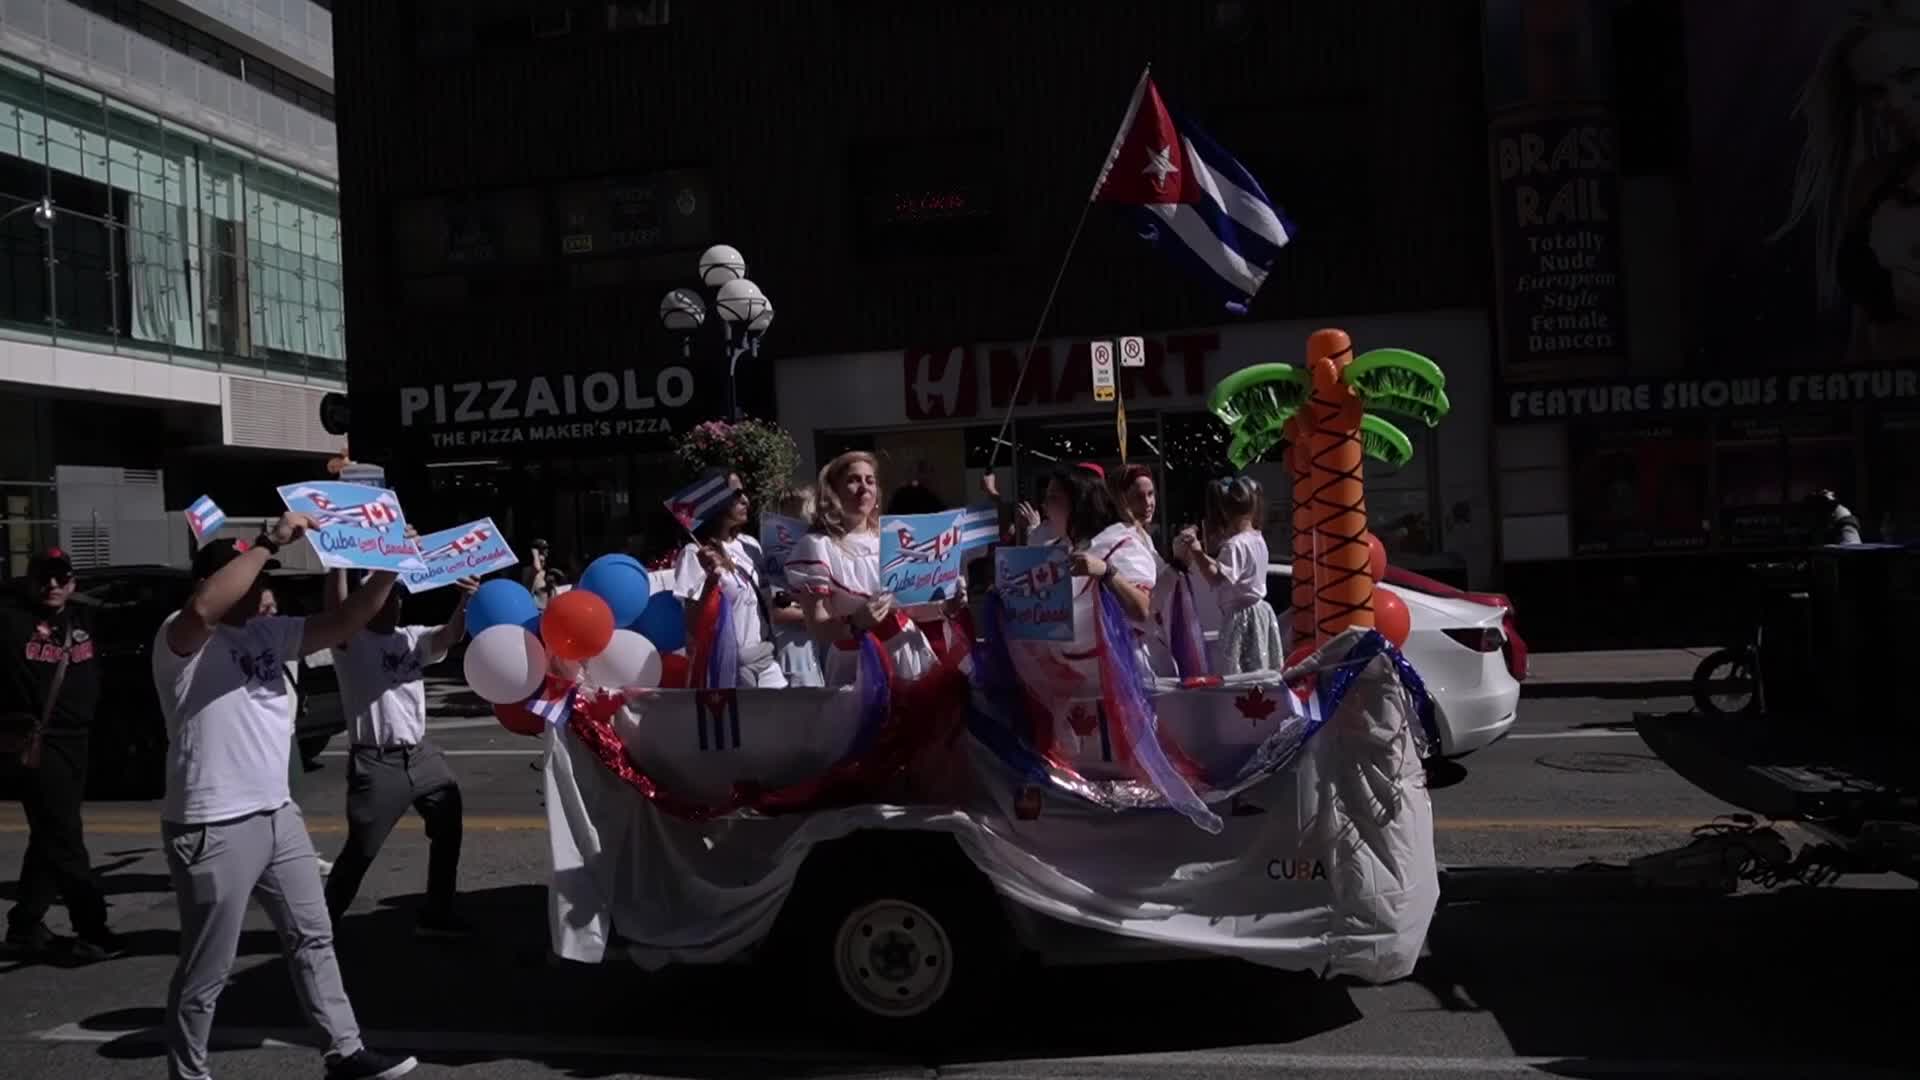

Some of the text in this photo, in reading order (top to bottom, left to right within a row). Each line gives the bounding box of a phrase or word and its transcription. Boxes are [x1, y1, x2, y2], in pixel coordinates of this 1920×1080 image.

[1499, 126, 1614, 180] BRASS
[1516, 177, 1608, 227] RAIL
[1527, 232, 1606, 254] Totally
[1541, 252, 1600, 272] Nude
[1516, 271, 1616, 295] European
[1543, 289, 1600, 312] Style
[1529, 311, 1609, 334] Female
[1528, 332, 1617, 354] Dancers
[400, 365, 695, 428] PIZZAIOLO
[1508, 383, 1651, 418] FEATURE
[1663, 377, 1778, 410] SHOWS
[432, 417, 672, 448] THE PIZZA MAKER'S PIZZA
[320, 530, 358, 552] Cuba
[411, 567, 445, 584] Cuba
[466, 548, 507, 568] Canada
[886, 569, 914, 593] Cuba
[1267, 860, 1327, 880] CUBA
